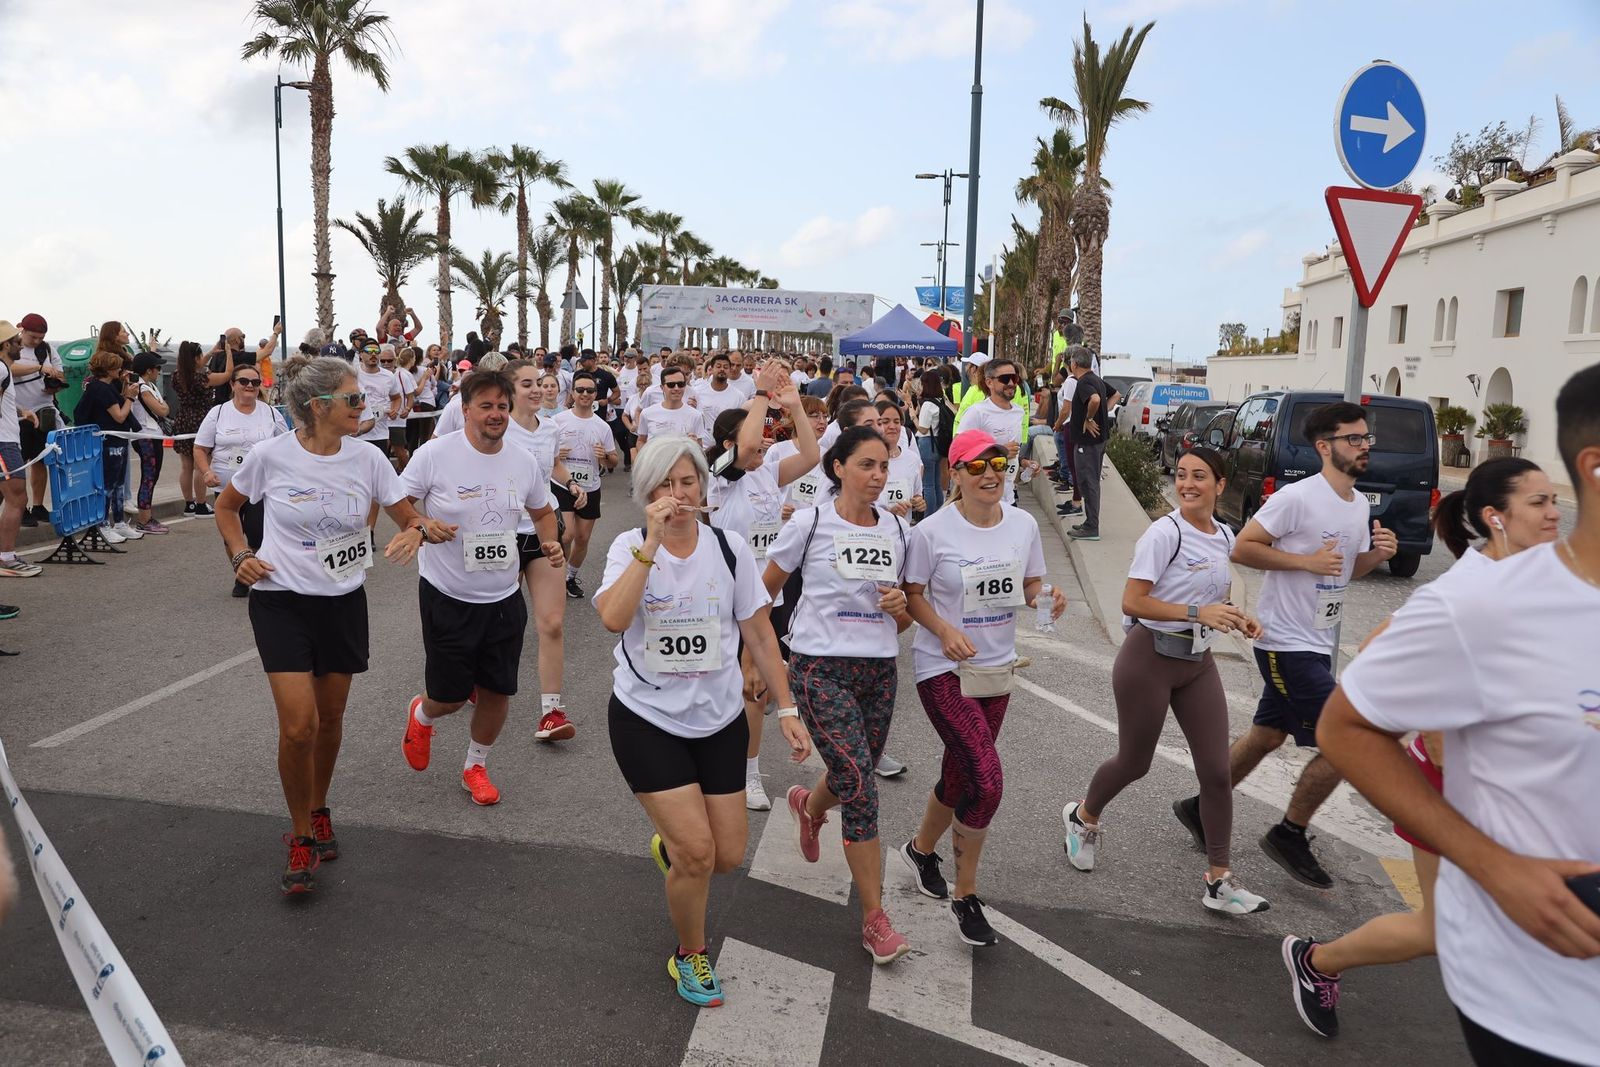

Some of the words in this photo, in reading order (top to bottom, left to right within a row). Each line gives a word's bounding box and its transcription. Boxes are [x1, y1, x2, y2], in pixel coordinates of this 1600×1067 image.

[715, 294, 729, 303] 3A
[731, 295, 782, 305] CARRERA
[784, 297, 798, 306] 5K
[862, 343, 935, 351] info@dorsalchip.es
[236, 455, 244, 464] 9
[570, 472, 589, 481] 104
[887, 489, 904, 500] 76
[324, 541, 367, 570] 1205
[475, 544, 508, 560] 856
[841, 548, 892, 567] 1225
[976, 577, 1014, 596] 186
[659, 635, 707, 656] 309
